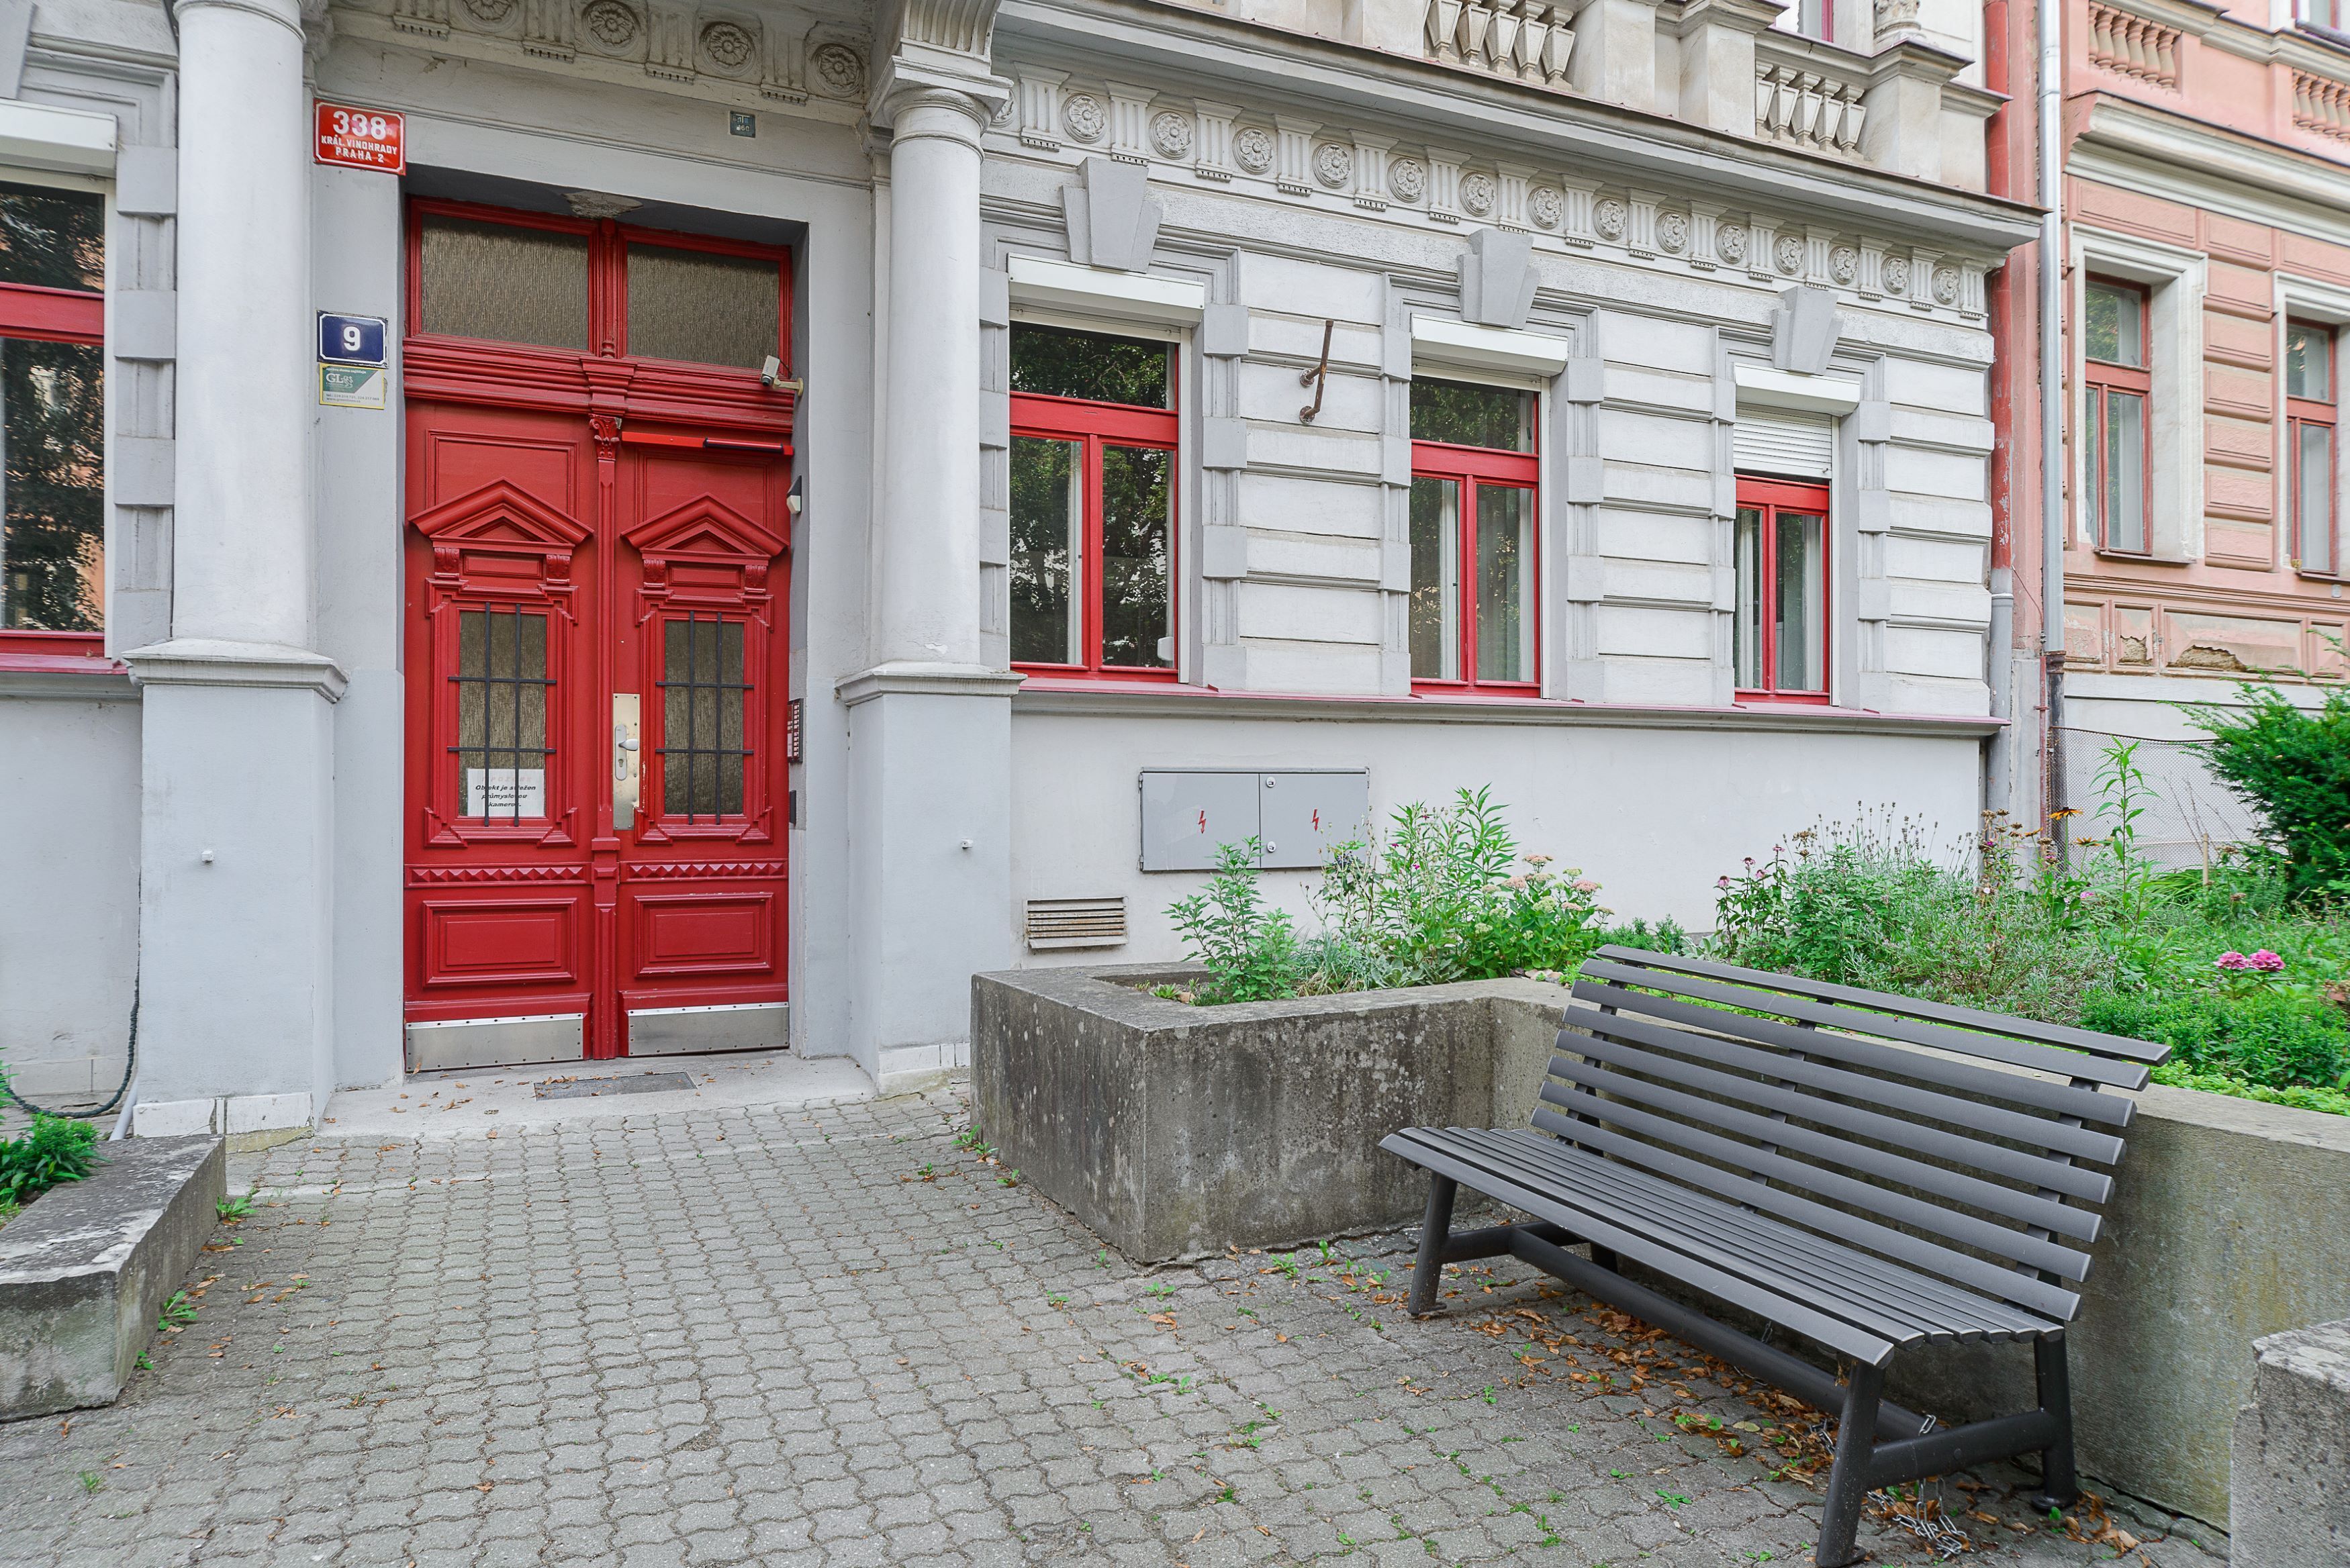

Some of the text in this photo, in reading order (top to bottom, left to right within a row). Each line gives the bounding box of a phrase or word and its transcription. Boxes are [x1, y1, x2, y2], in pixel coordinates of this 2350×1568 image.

[333, 111, 387, 140] 338
[321, 135, 398, 155] KRÁL. VINOHRADY
[336, 147, 385, 163] PRAHA 2
[343, 326, 361, 351] 9
